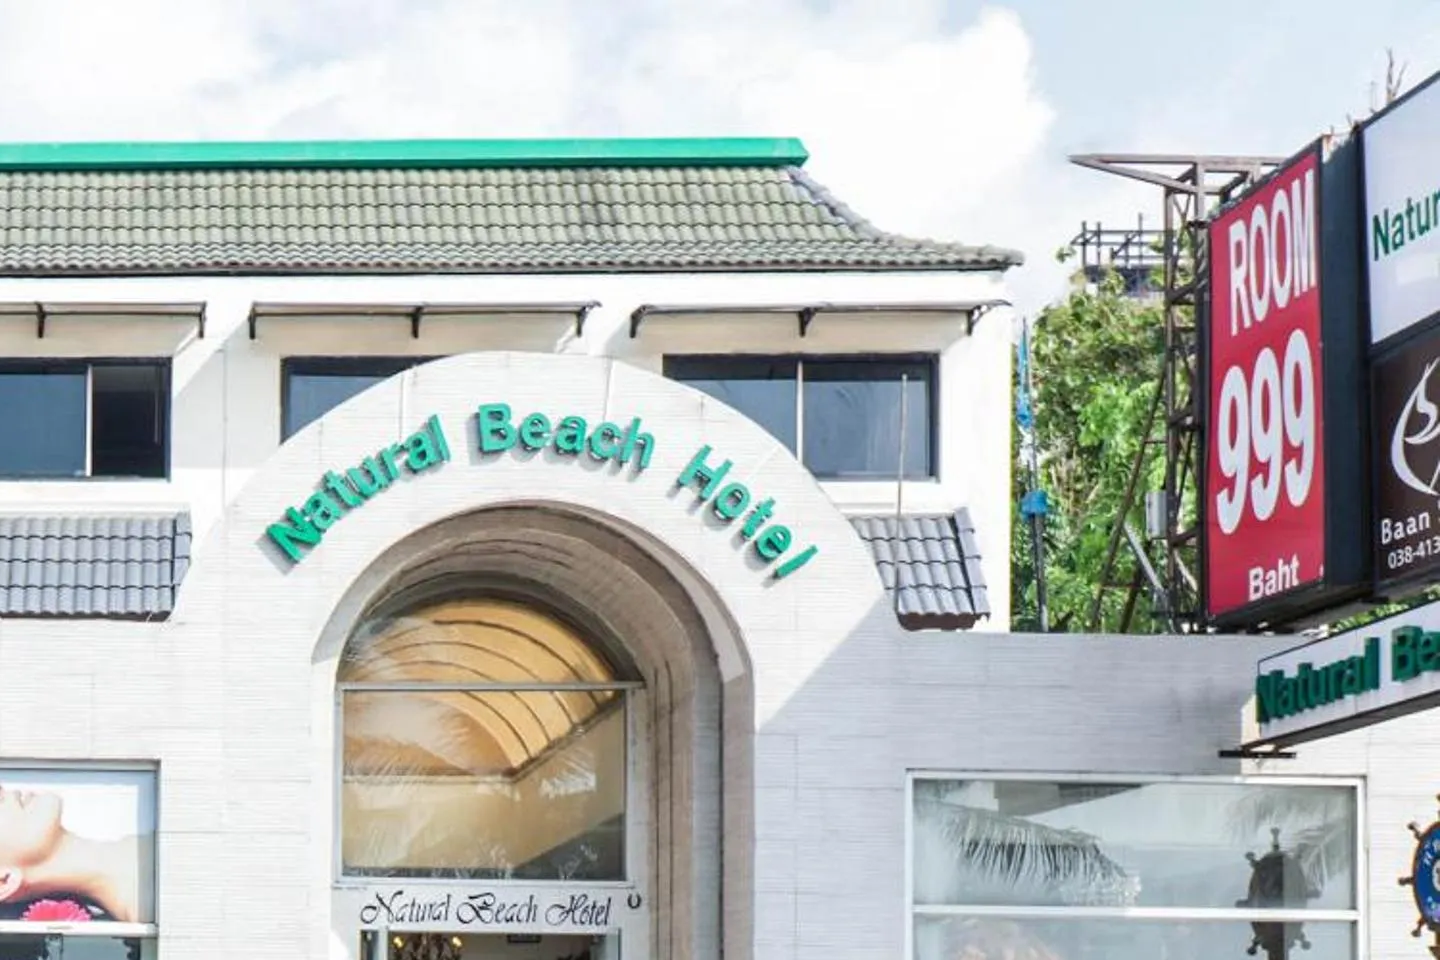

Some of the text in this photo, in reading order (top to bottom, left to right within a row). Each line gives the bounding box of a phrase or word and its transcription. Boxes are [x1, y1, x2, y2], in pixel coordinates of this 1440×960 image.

[1229, 169, 1316, 337] ROOM
[1217, 328, 1314, 535] 999
[265, 403, 819, 579] Natural Beach Hotel
[1381, 512, 1430, 545] Baan
[1248, 553, 1300, 601] Baht
[1256, 637, 1380, 723] Natural
[360, 890, 611, 926] Natural Beach Hotel
